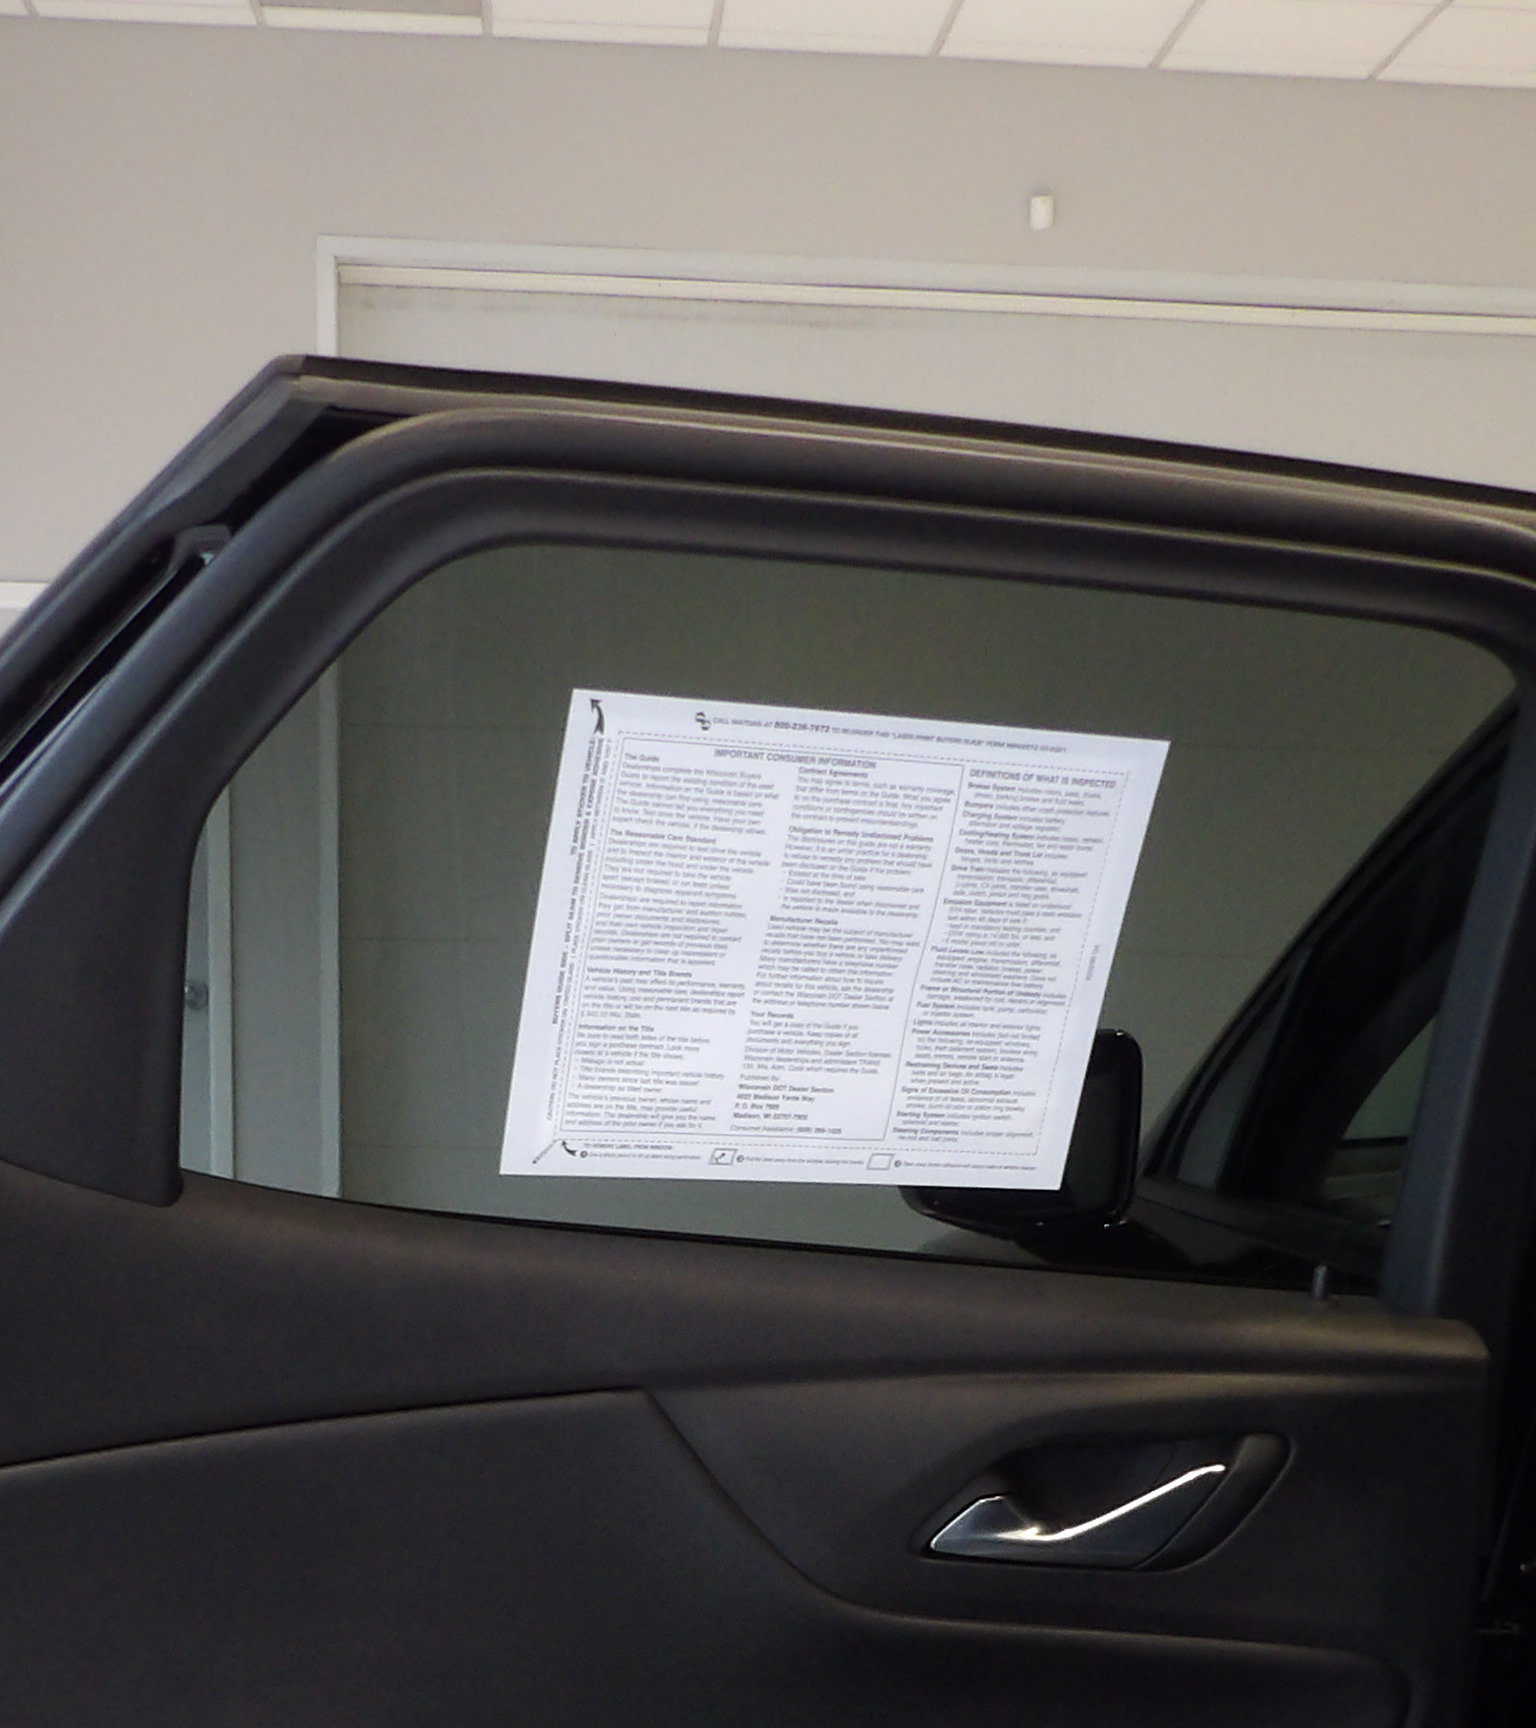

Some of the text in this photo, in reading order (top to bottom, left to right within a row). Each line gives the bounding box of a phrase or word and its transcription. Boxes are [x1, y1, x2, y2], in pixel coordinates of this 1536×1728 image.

[624, 752, 660, 762] The Guide
[714, 747, 876, 769] IMPORTANT CONSUMER INFORMATION
[798, 766, 868, 779] Contract Agreements
[969, 768, 1116, 788] DEFINITIONS OF WHAT IS INSPECTED
[609, 828, 716, 843] The Reasonable Care Standard
[769, 914, 838, 925] Manufacturer Recalls
[612, 967, 637, 976] History
[667, 970, 692, 978] Brands
[578, 1022, 616, 1030] Information
